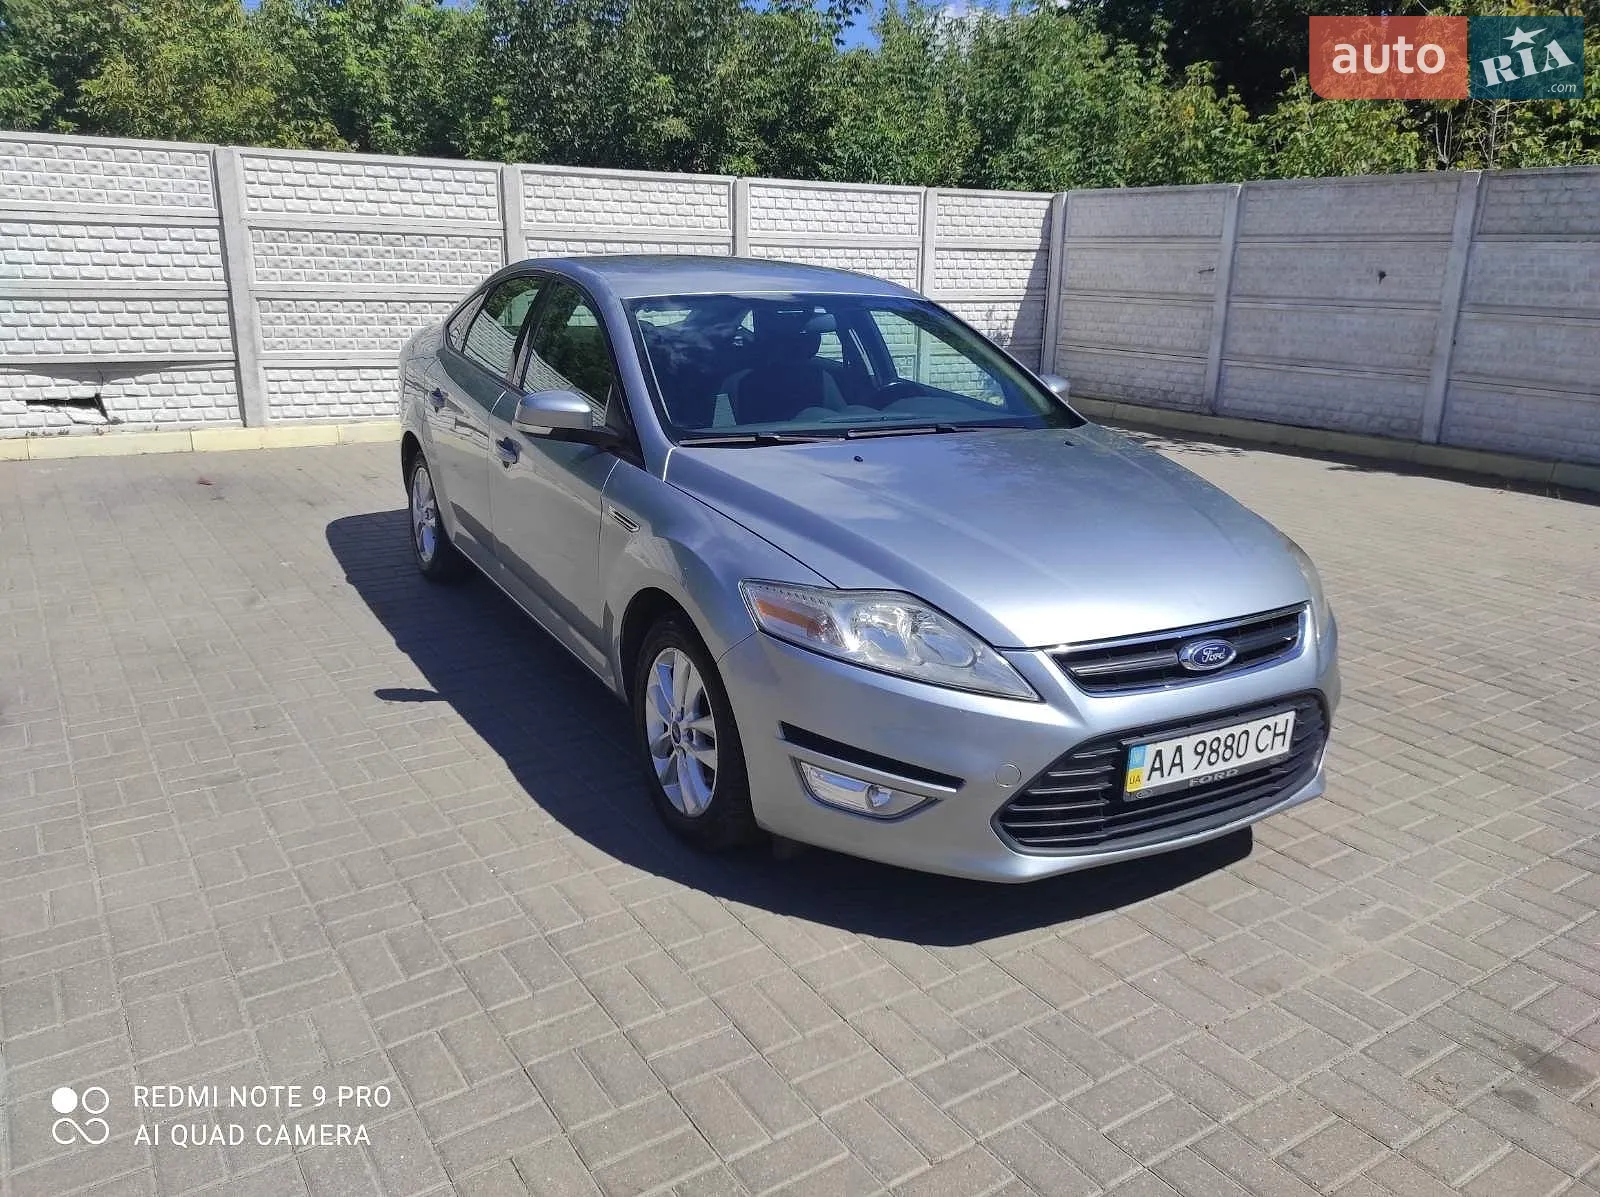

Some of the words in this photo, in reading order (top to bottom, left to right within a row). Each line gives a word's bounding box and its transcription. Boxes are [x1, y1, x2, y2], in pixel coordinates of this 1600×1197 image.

[1201, 647, 1226, 663] Ford
[1147, 744, 1184, 781] AA
[1193, 730, 1250, 770] 9880
[1255, 719, 1289, 753] CH
[1129, 775, 1141, 785] UA
[1190, 768, 1240, 787] FORD
